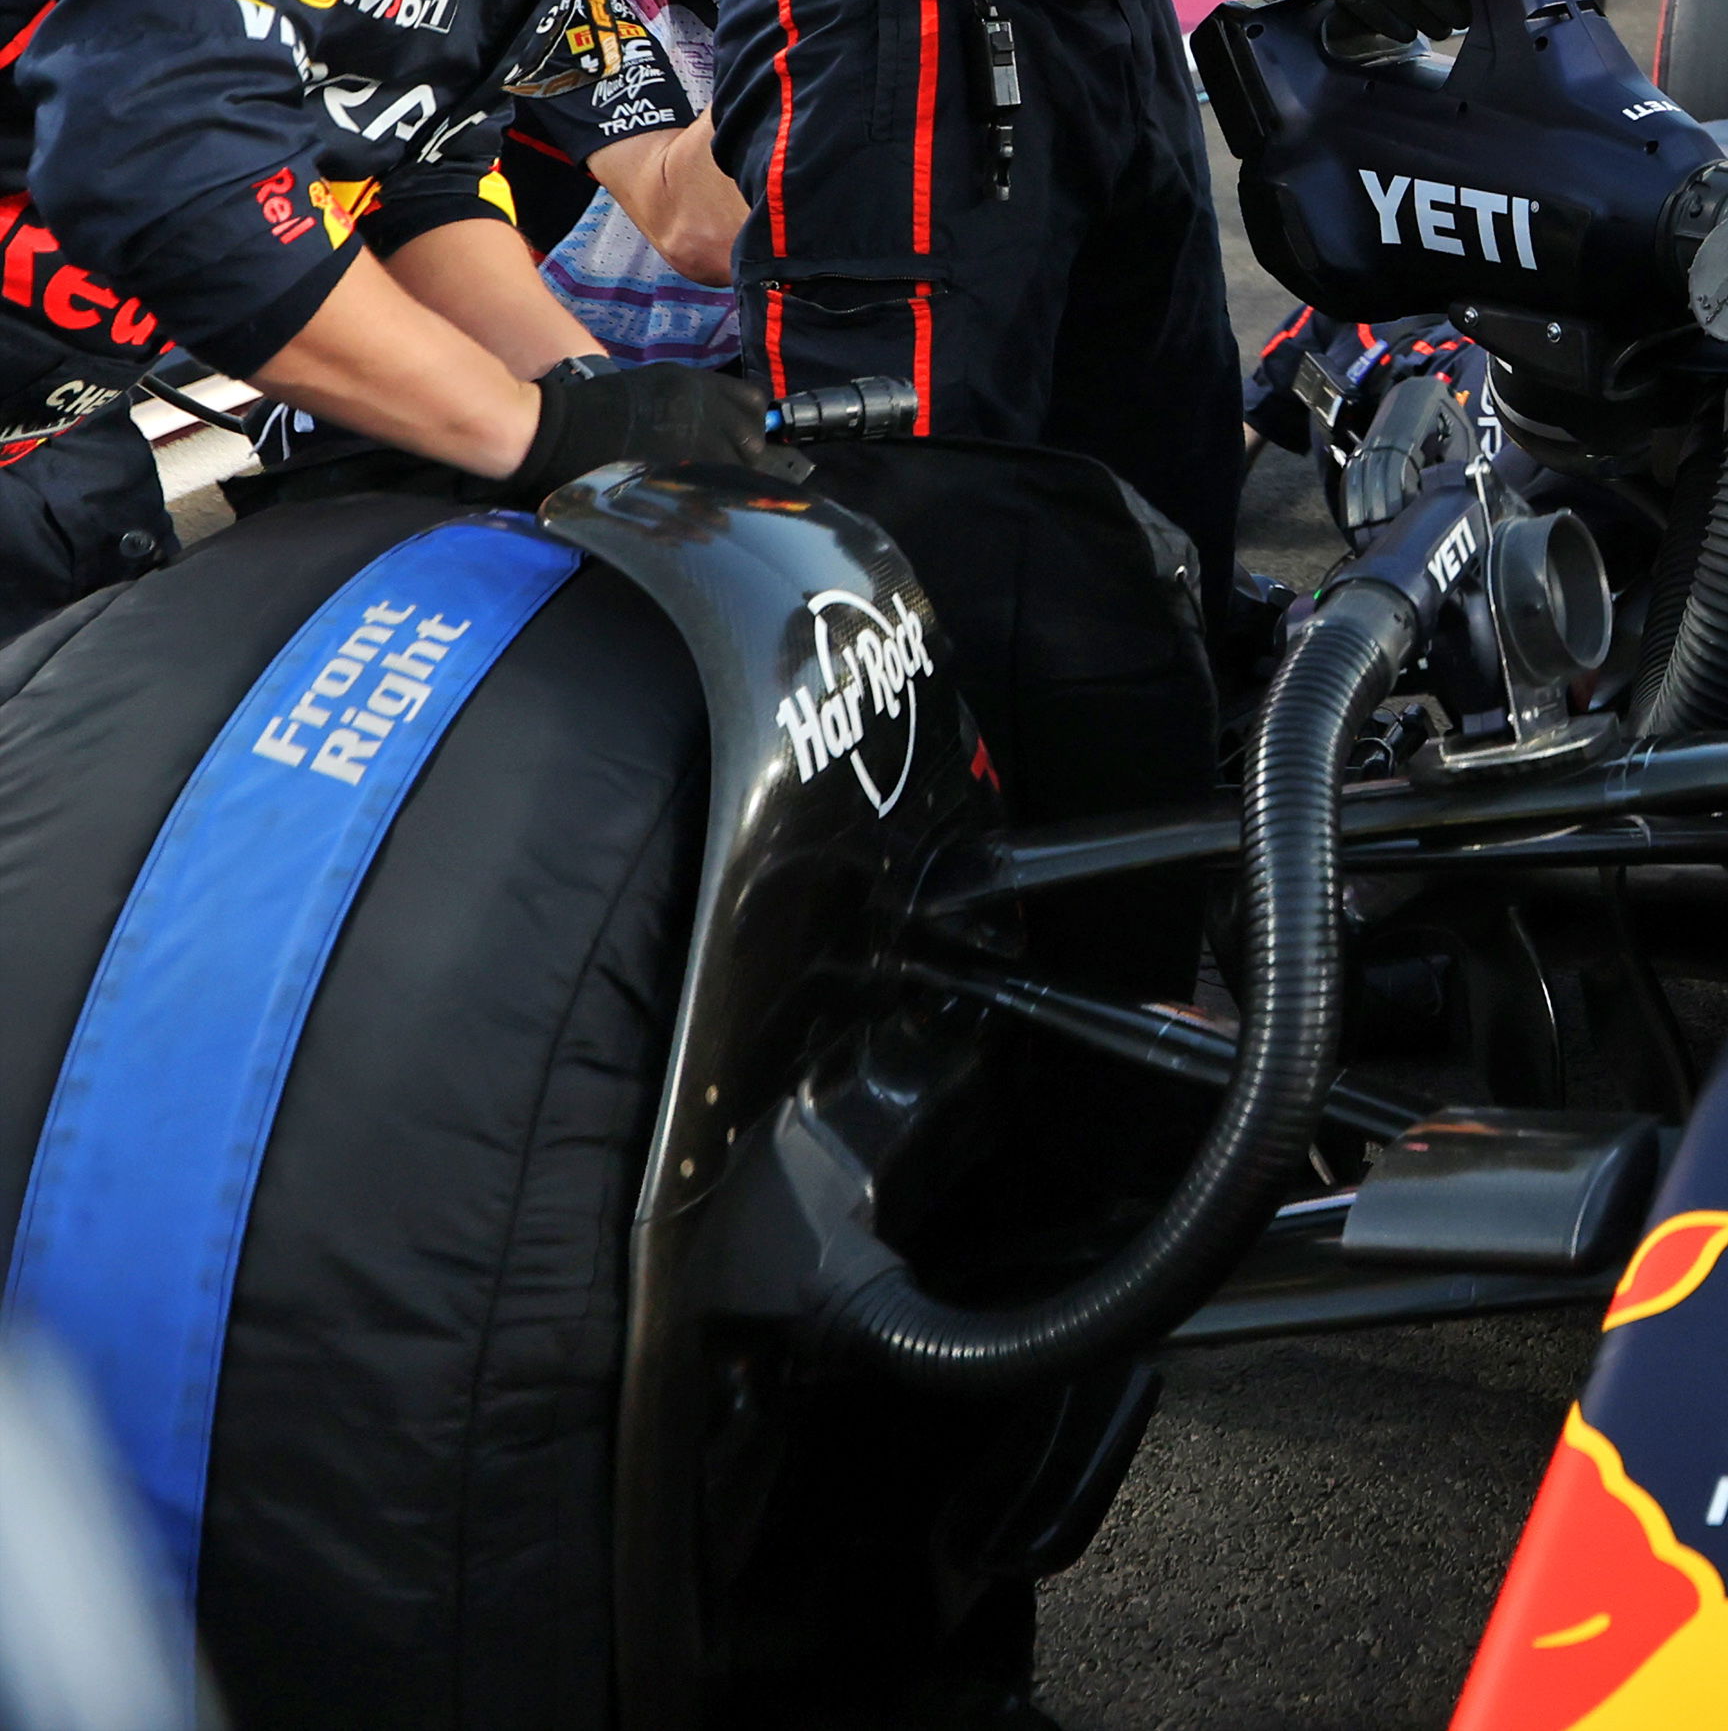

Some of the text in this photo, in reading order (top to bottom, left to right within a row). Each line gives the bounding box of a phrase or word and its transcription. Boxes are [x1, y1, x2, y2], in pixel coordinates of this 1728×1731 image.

[598, 107, 676, 139] TRADE
[612, 98, 657, 121] AVA
[1358, 168, 1540, 271] YETI
[1427, 515, 1478, 593] YETI
[252, 597, 417, 768] Front
[309, 612, 473, 788] Right
